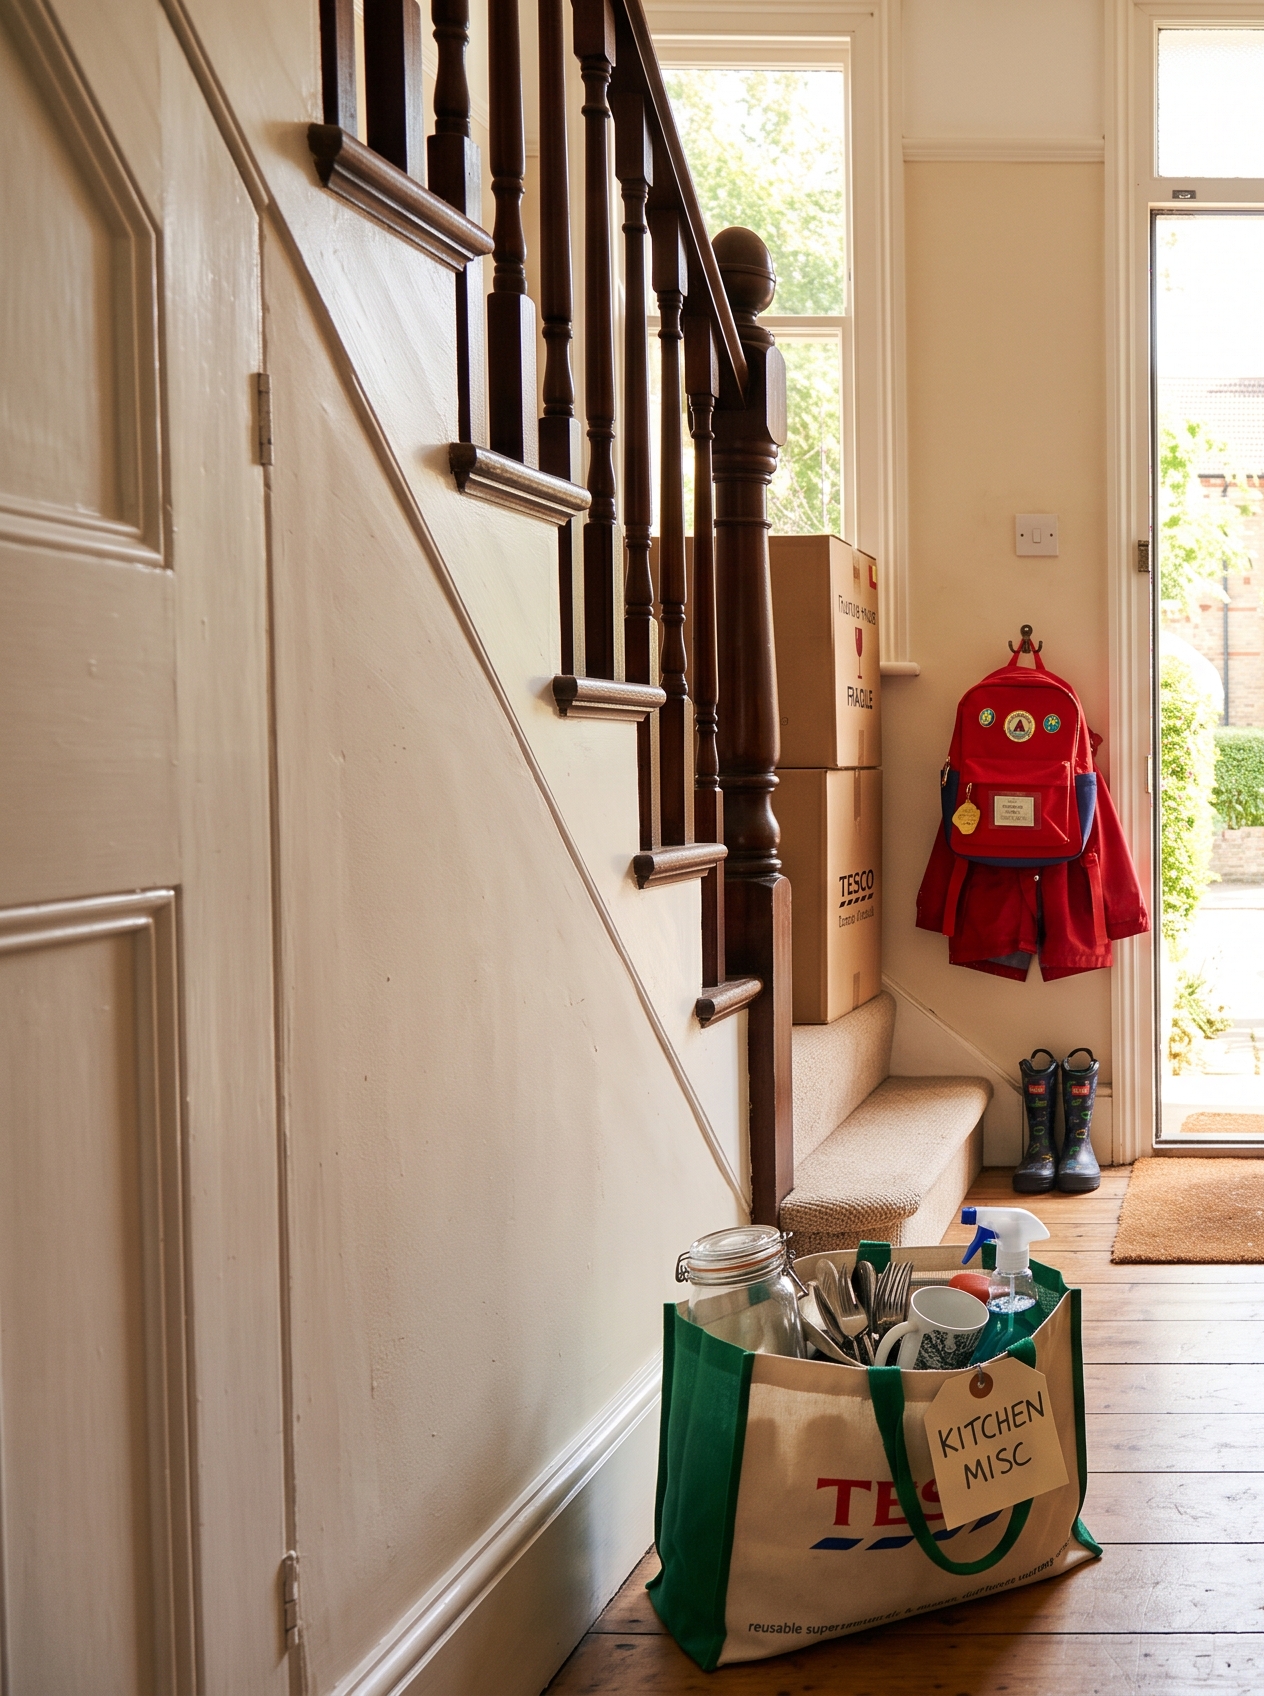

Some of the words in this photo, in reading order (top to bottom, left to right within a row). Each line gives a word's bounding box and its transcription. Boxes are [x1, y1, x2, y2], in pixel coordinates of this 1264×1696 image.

[838, 869, 874, 897] TESCO
[937, 1391, 1046, 1459] KITCHEN
[963, 1441, 1033, 1490] MISC
[816, 1477, 945, 1526] TES
[748, 1622, 803, 1634] reusable
